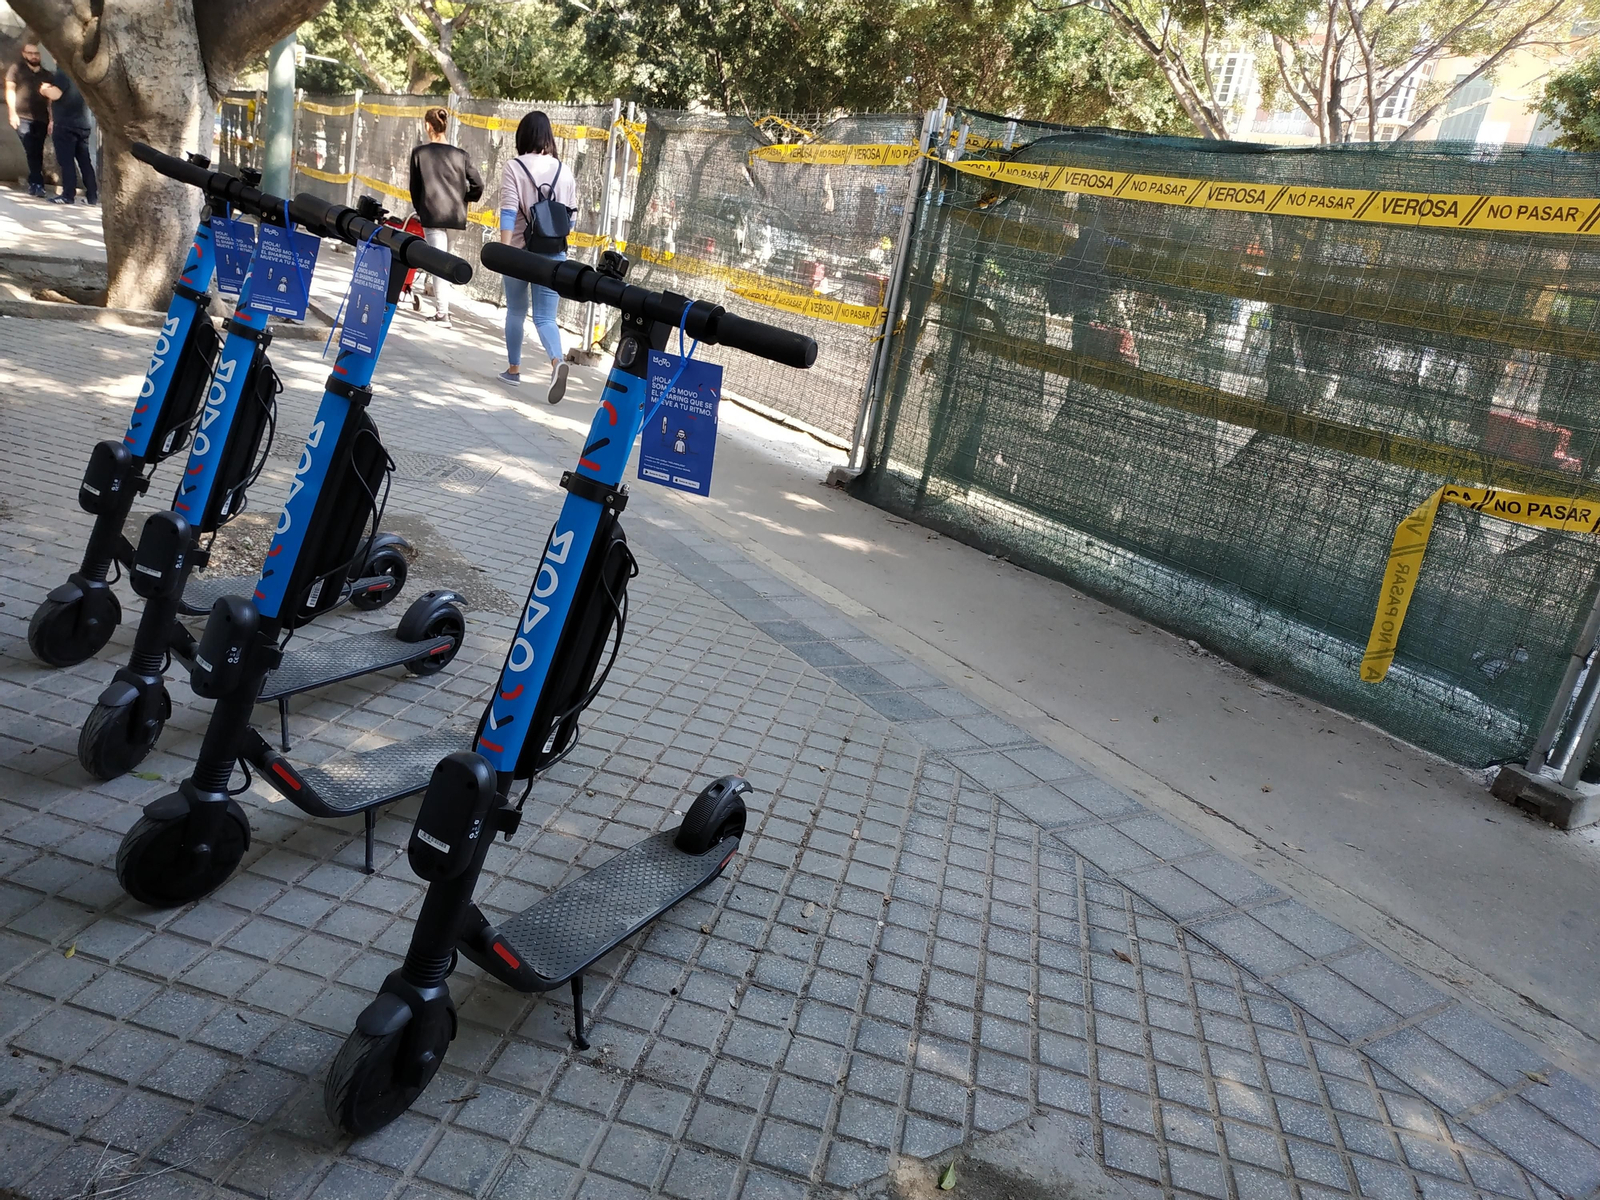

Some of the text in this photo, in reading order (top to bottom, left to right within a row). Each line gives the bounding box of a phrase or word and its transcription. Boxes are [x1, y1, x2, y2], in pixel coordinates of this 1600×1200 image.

[853, 149, 881, 160] VEROSA
[891, 150, 902, 158] NO
[1020, 168, 1050, 182] PASAR
[1064, 171, 1114, 190] VEROSA
[1130, 180, 1147, 193] NO
[1148, 182, 1188, 197] PASAR
[1208, 186, 1266, 205] VEROSA
[1286, 194, 1306, 206] NO
[1308, 194, 1356, 210] PASAR
[1381, 197, 1459, 219] VEROSA
[1486, 204, 1512, 220] NO
[1516, 204, 1580, 222] PASAR
[262, 245, 282, 253] SOMOS
[268, 251, 292, 260] SHARING
[260, 254, 278, 263] MUEVE
[810, 302, 834, 316] VEROSA
[841, 308, 850, 318] NO
[850, 309, 870, 320] PASAR
[652, 376, 672, 385] ¡HOLA
[652, 382, 698, 398] SOMS MOVO
[651, 396, 673, 408] MEVE
[680, 403, 688, 411] TU
[689, 406, 712, 416] RITMO.
[660, 392, 689, 404] SARING
[690, 398, 704, 408] QUE
[704, 402, 712, 410] SE
[1494, 499, 1592, 524] NO PASAR
